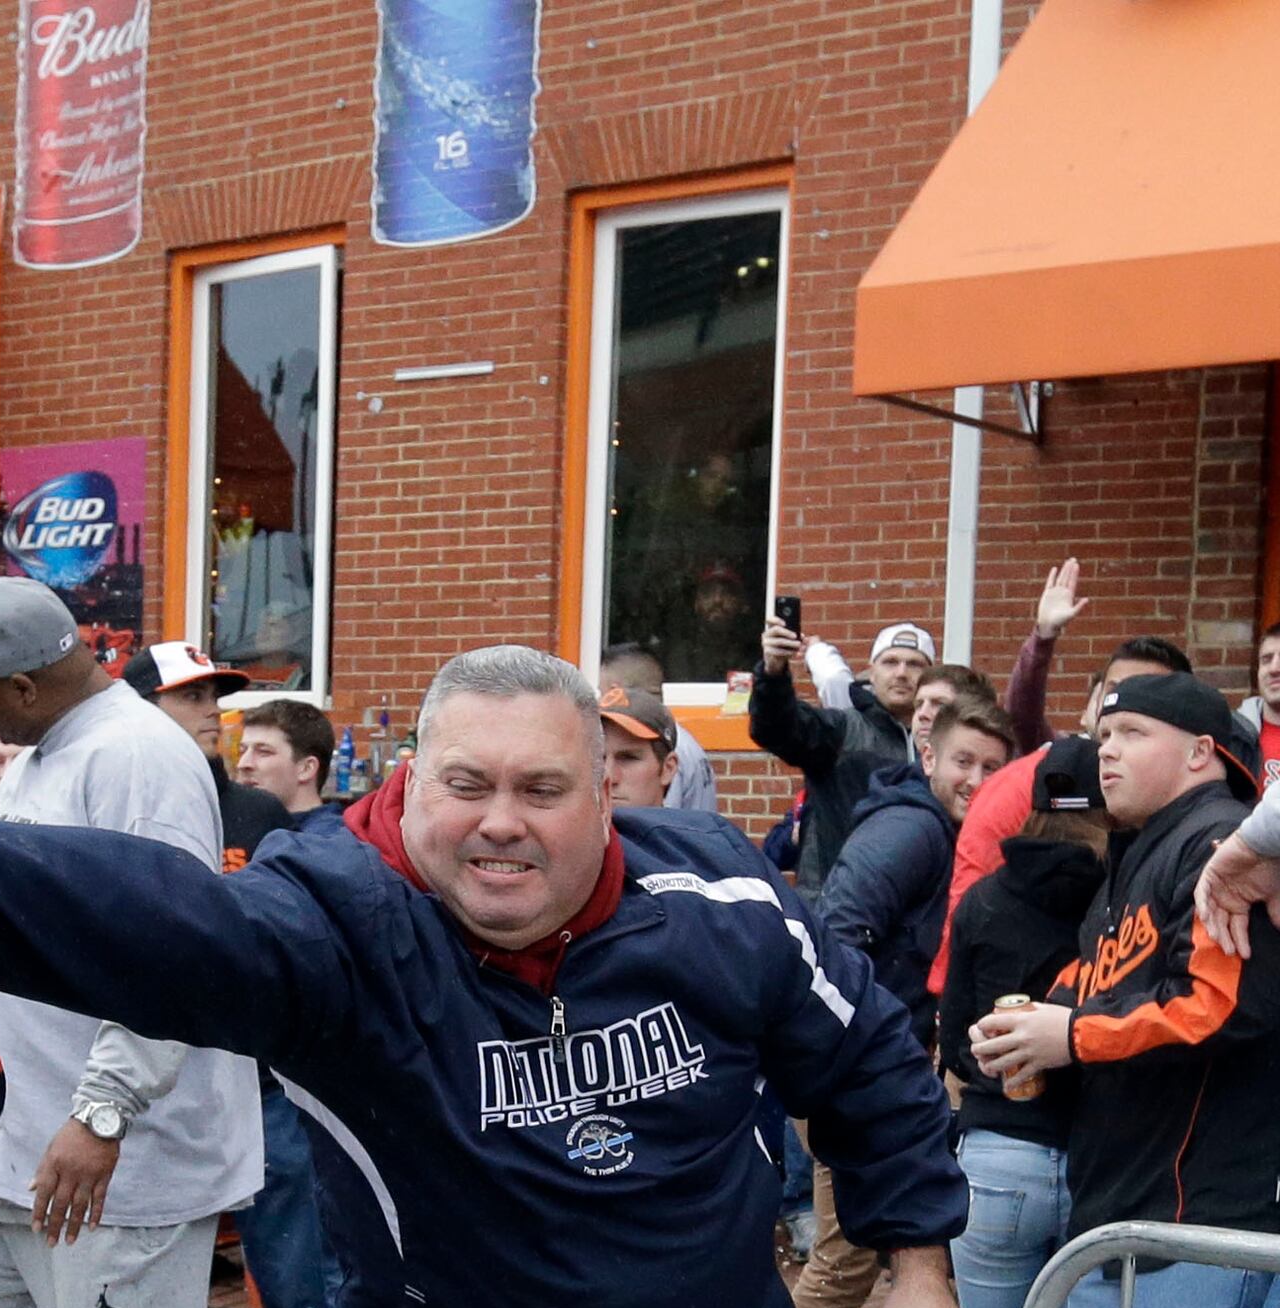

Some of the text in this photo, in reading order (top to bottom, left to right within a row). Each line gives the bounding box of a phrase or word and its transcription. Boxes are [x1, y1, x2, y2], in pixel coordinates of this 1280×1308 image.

[435, 130, 468, 161] 16
[35, 496, 106, 524] BUD
[18, 522, 115, 551] LIGHT
[646, 876, 695, 893] SHINGTON
[1077, 903, 1160, 1007] rioles
[481, 1062, 710, 1132] POLICE WEEK
